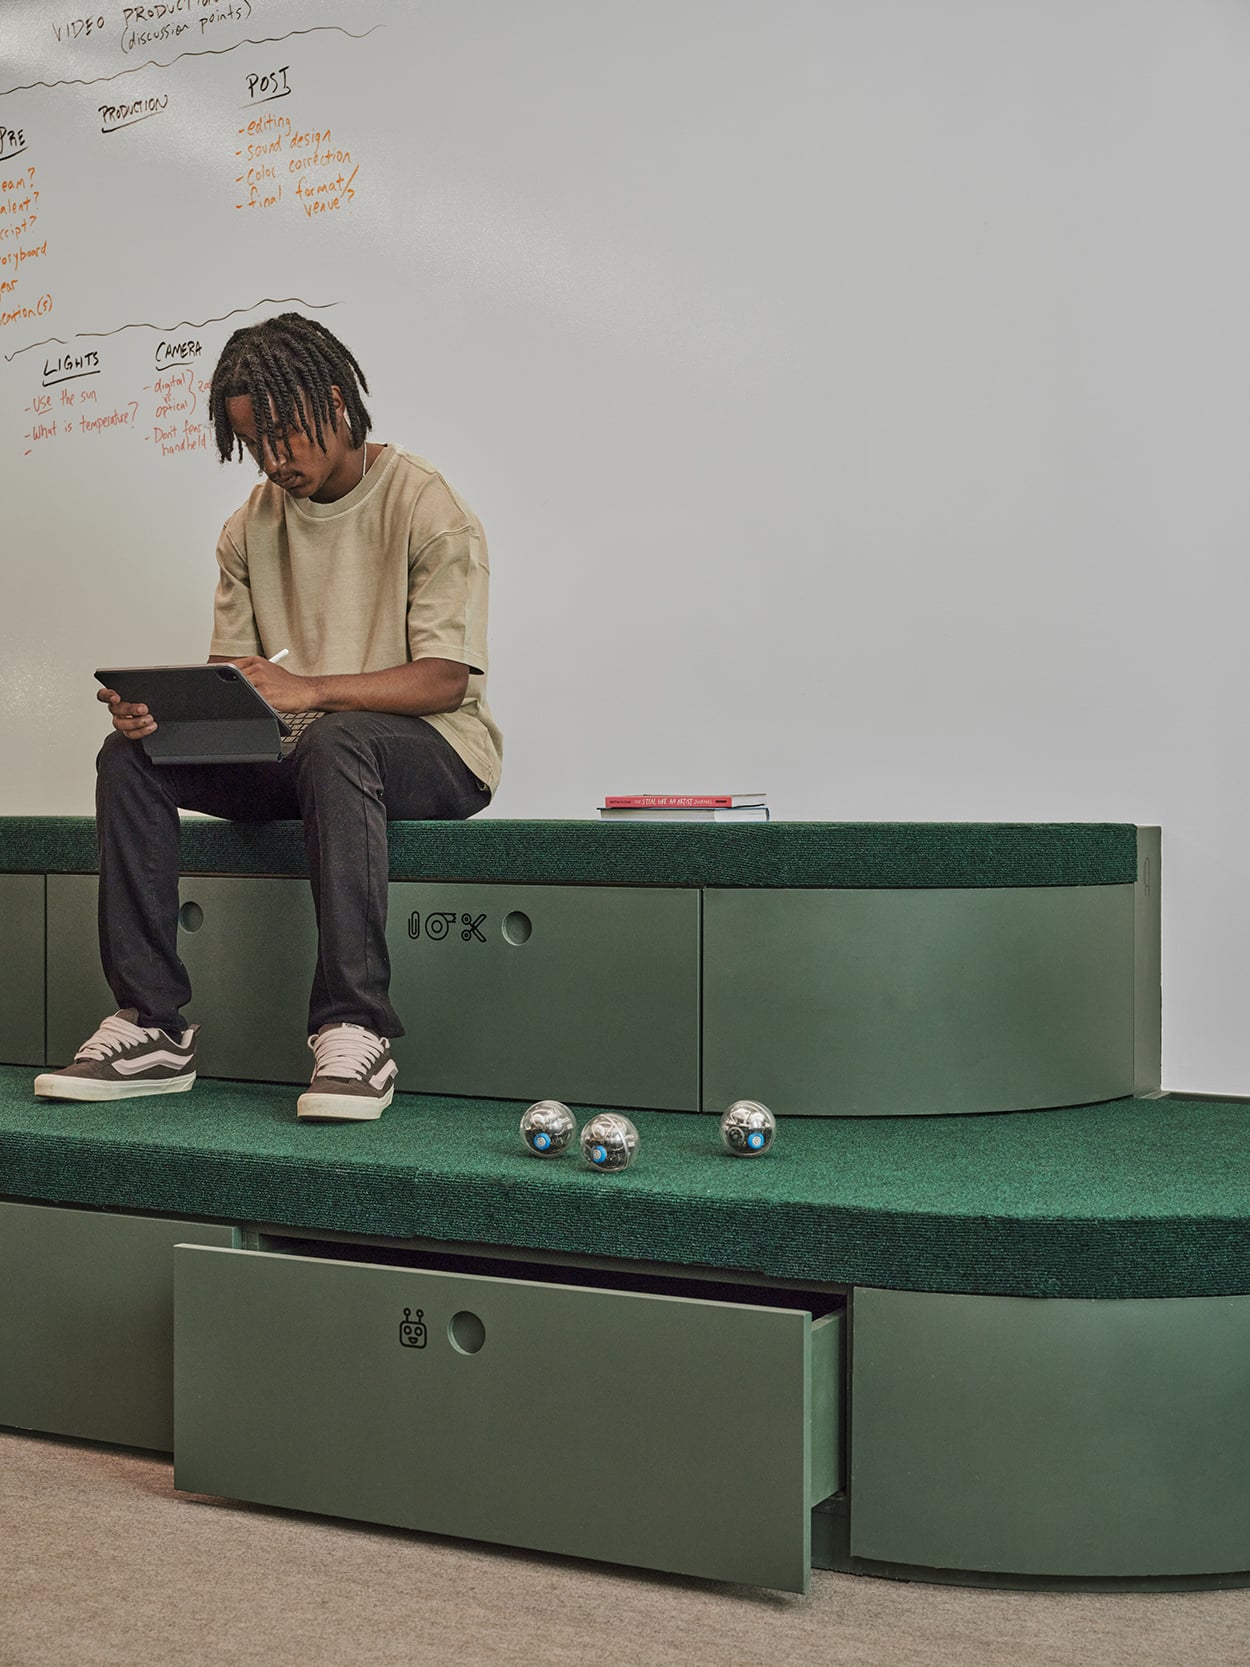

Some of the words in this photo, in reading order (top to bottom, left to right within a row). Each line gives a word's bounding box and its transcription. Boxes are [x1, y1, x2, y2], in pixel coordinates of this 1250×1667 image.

[52, 16, 105, 42] VIDEO
[123, 0, 219, 27] PRODUCT
[246, 66, 290, 98] POST
[98, 94, 169, 124] PRODUCTION
[290, 128, 331, 153] design
[289, 147, 352, 174] correction
[0, 240, 48, 272] oryboard
[0, 279, 19, 295] ear
[0, 292, 53, 327] cation(s)
[43, 351, 100, 377] LIGHTS
[155, 341, 203, 362] CAMERA
[60, 388, 76, 407] the
[80, 390, 98, 404] sun
[64, 420, 73, 433] is
